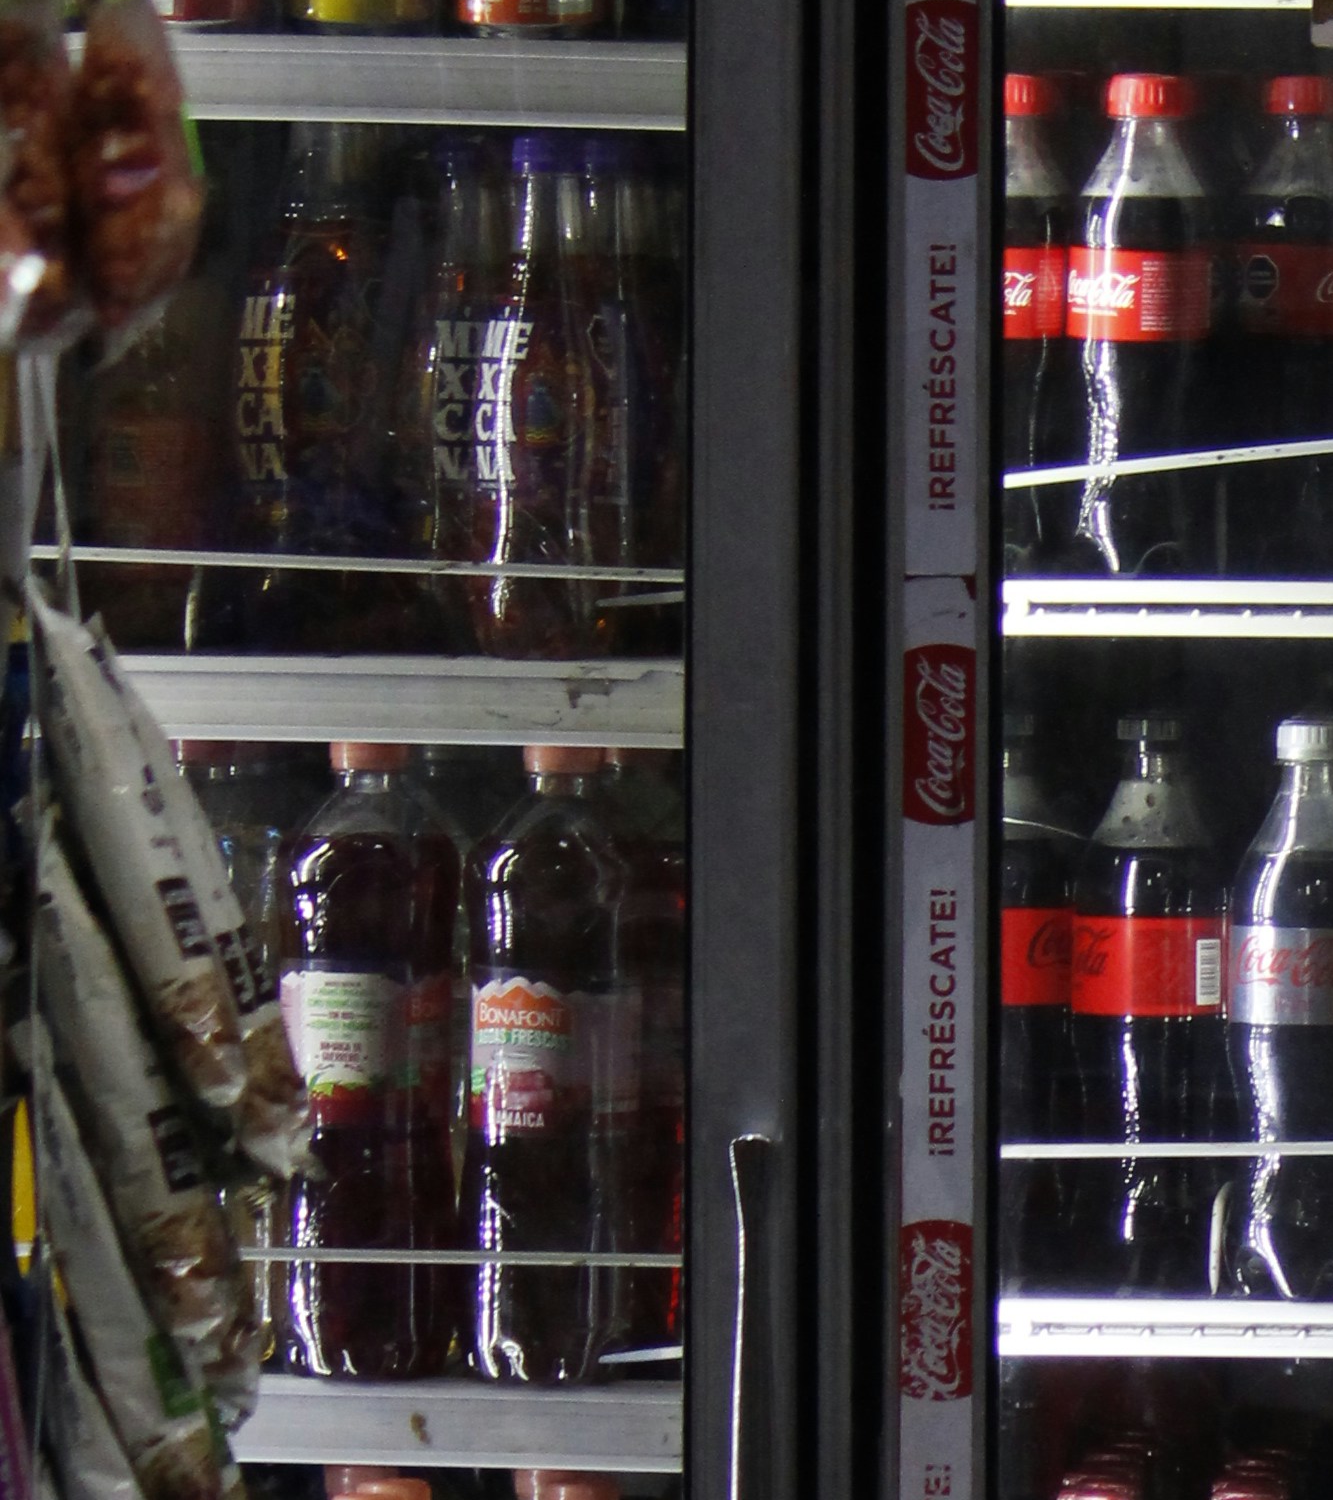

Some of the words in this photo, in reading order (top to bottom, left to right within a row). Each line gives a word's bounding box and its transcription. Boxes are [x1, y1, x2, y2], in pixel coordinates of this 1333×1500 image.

[913, 656, 964, 817] Coca-Cola
[480, 1003, 563, 1027] BONAFONT
[928, 889, 955, 1157] ¡REFRÉSCATE!
